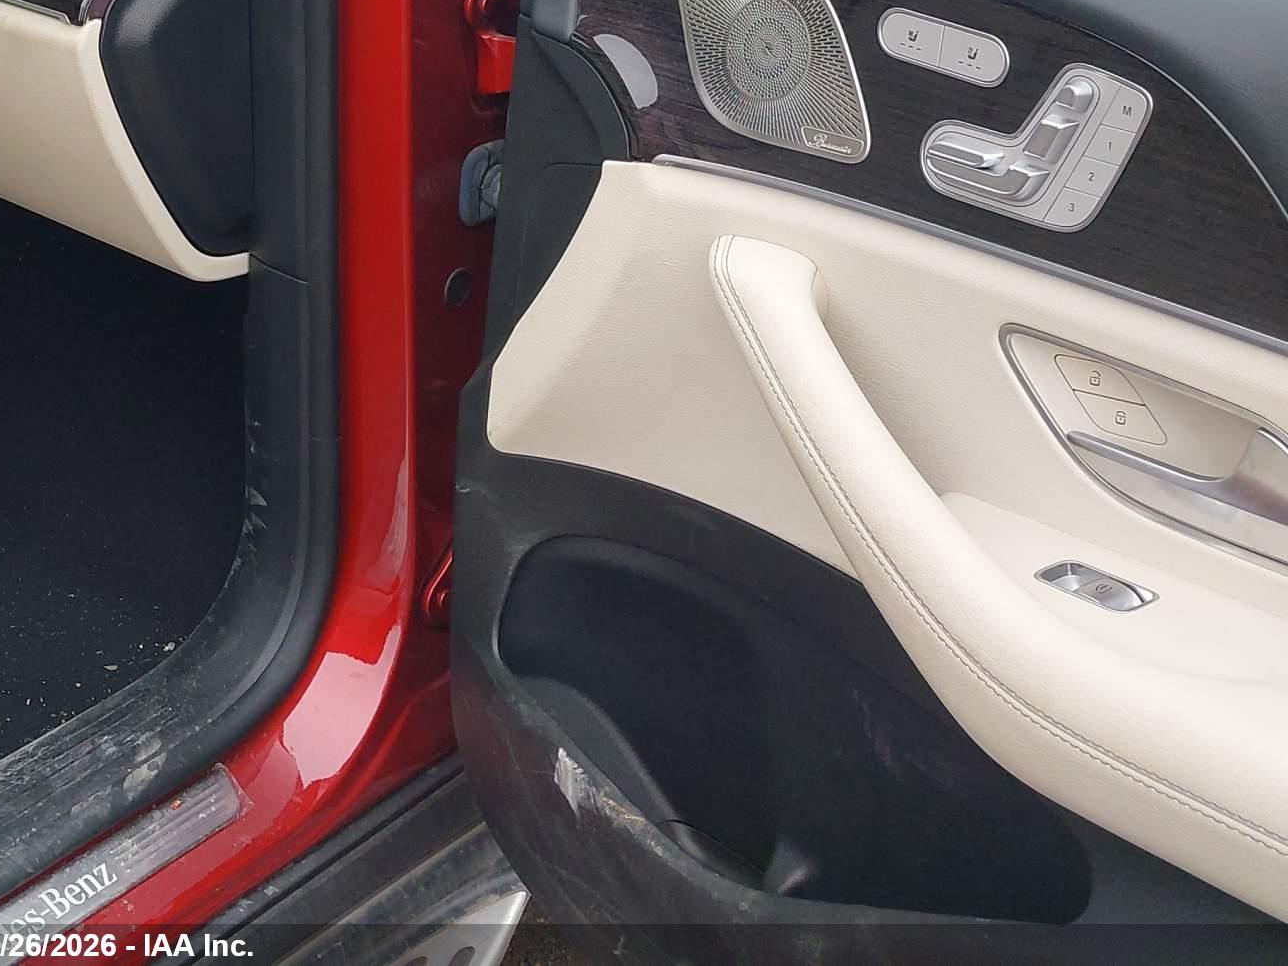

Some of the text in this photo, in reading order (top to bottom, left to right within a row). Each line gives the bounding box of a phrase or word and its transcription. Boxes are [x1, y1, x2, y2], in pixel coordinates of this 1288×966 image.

[1122, 105, 1132, 116] M
[1088, 171, 1095, 182] 2
[1068, 202, 1075, 212] 3
